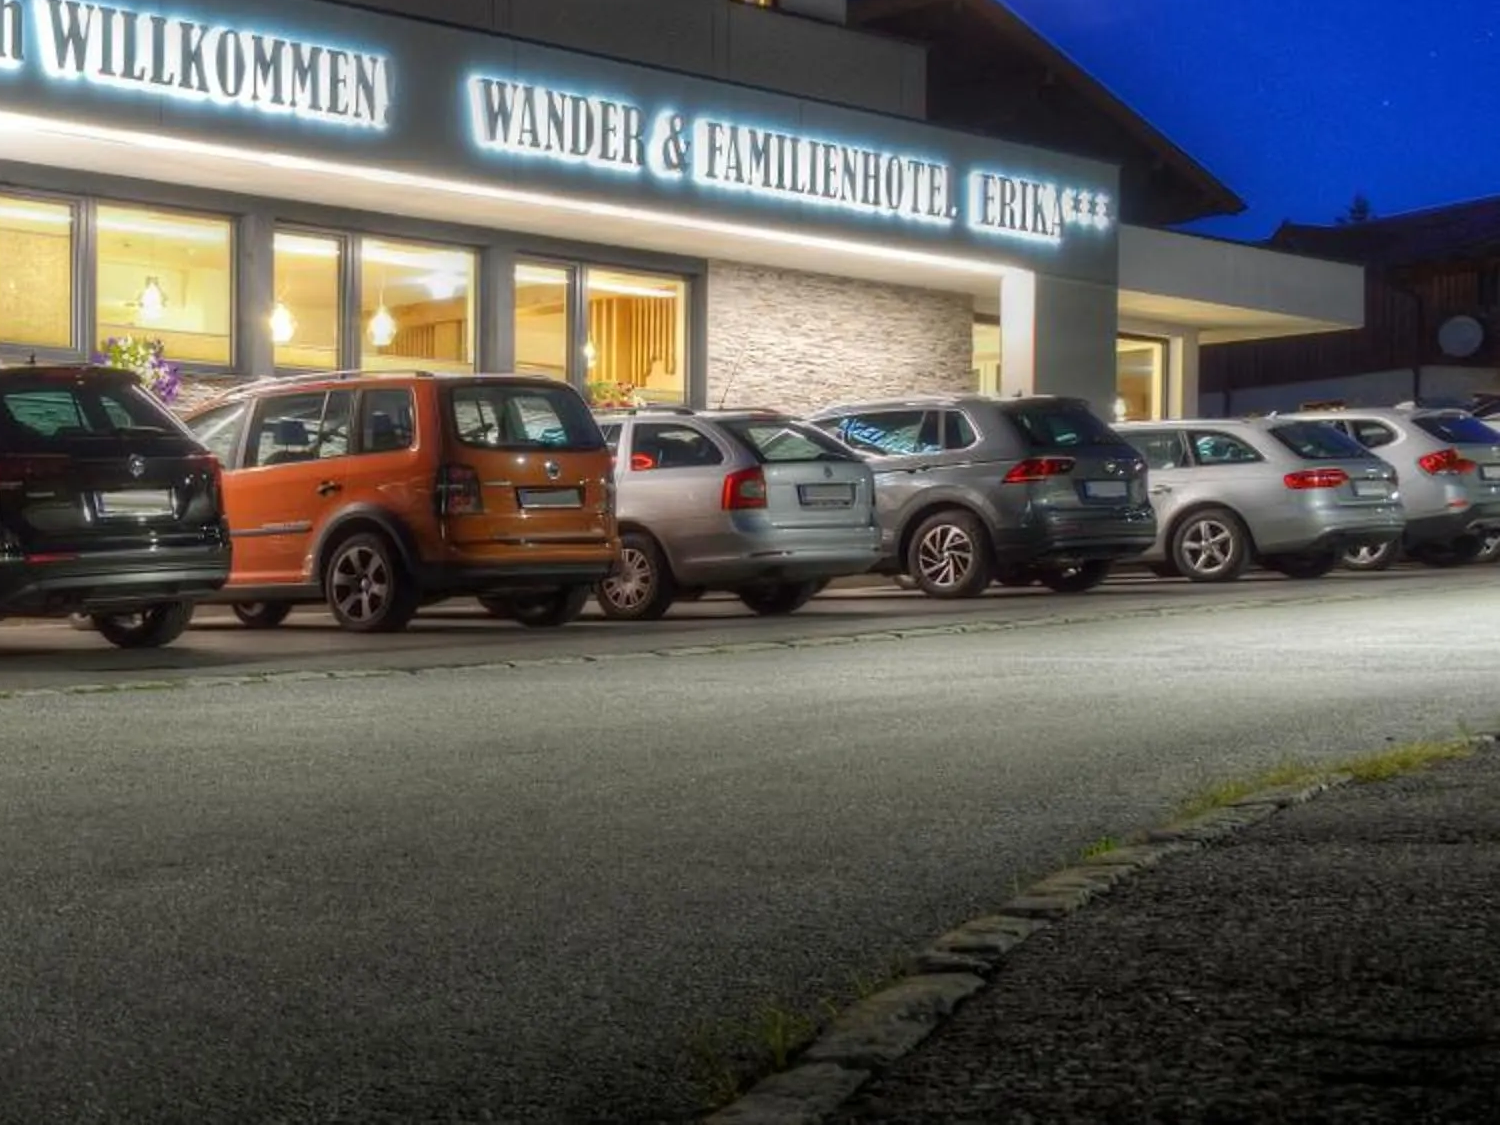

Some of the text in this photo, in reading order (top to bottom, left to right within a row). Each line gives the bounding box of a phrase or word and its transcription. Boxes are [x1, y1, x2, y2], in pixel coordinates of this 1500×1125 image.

[479, 78, 646, 167] WANDER
[662, 113, 690, 174] &
[704, 121, 959, 220] FAMILIENHOTEL
